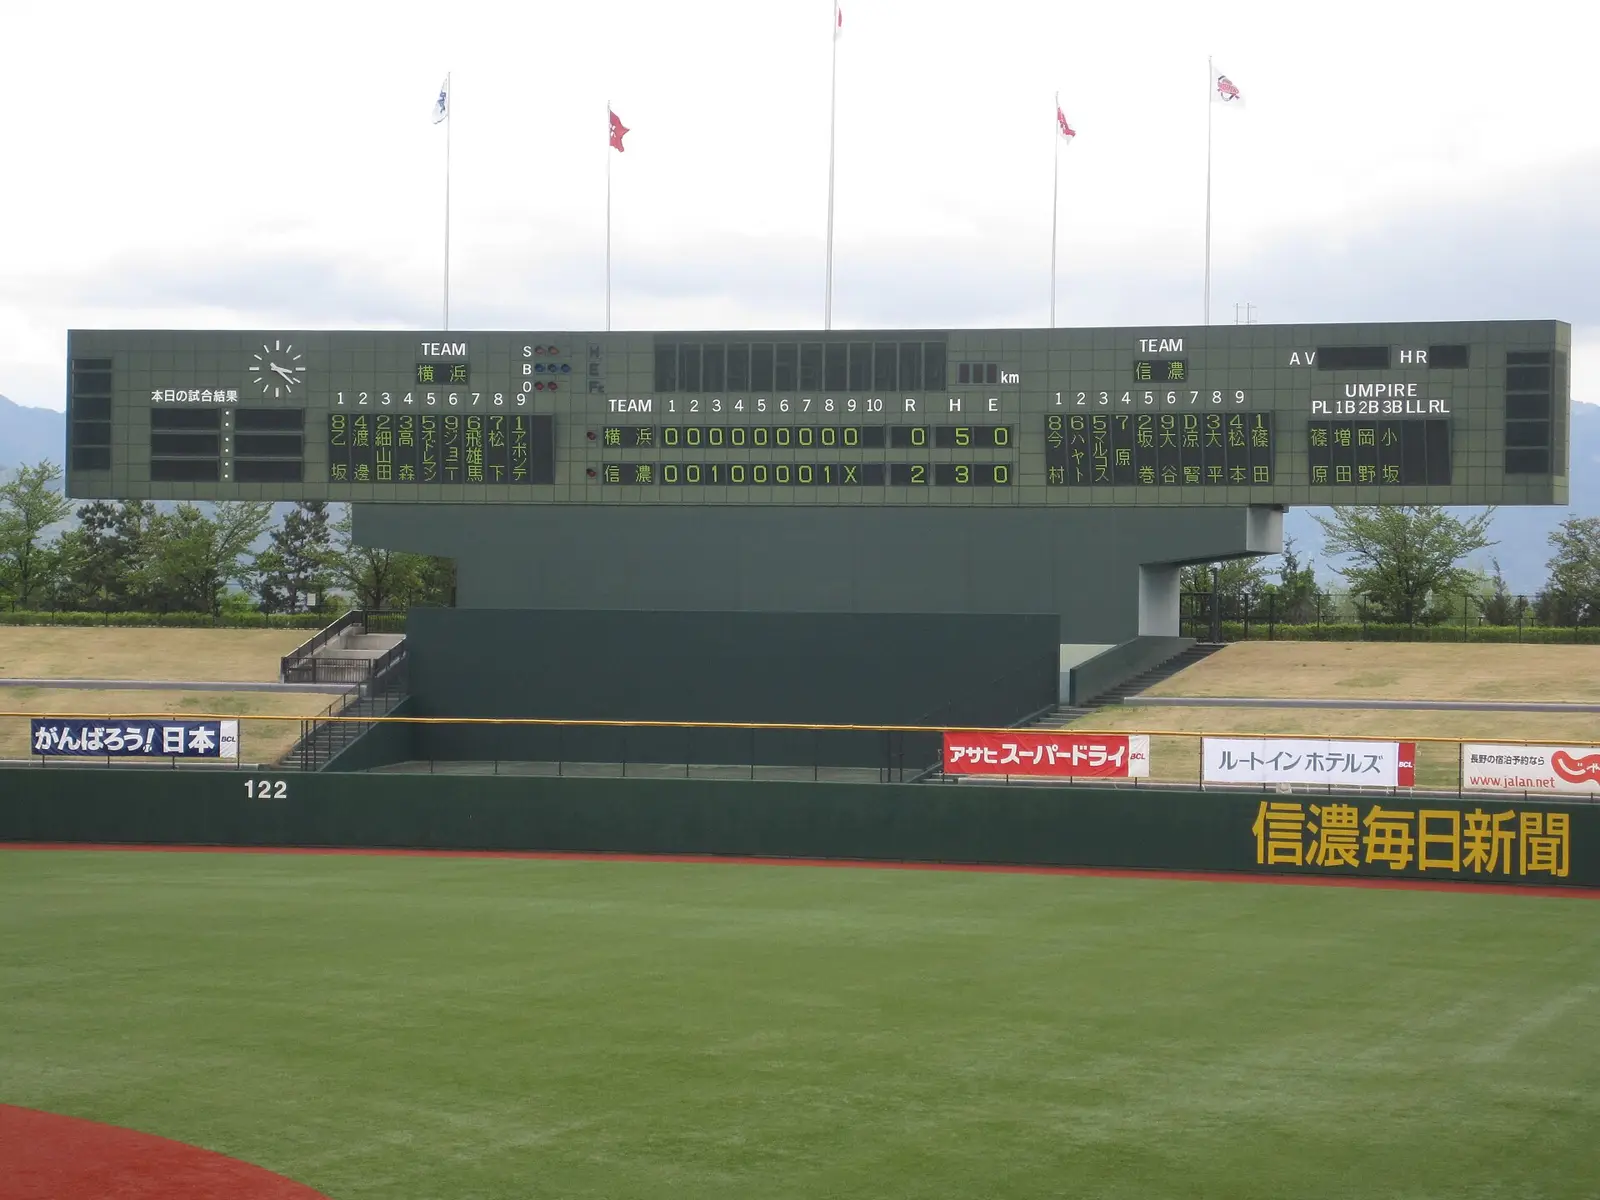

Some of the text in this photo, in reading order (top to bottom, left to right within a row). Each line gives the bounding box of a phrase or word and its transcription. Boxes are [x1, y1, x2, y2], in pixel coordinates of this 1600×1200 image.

[421, 342, 466, 356] TEAM
[522, 345, 532, 358] S
[1139, 338, 1183, 353] TEAM
[417, 364, 466, 382] 横浜
[522, 363, 532, 375] B
[1135, 361, 1184, 380] 信濃
[1000, 370, 1020, 384] km
[151, 389, 238, 403] 本日の試合結果
[1055, 390, 1245, 405] 1 2 3 4 5 6 7 8 9
[1345, 383, 1418, 398] UMPIRE
[337, 391, 526, 406] 1 2 3 4 5 6 7 8 9
[608, 398, 998, 413] TEAM 1 2 3 4 5 6 7 8 9 10 R H E
[1312, 399, 1450, 414] PL 1B 2B 3B LL RL
[604, 427, 1008, 446] 横浜 0 0 0 0 0 0 0 0 0 0 5 0
[605, 464, 652, 483] 信濃
[664, 464, 678, 483] 0
[686, 464, 701, 483] 0
[711, 465, 718, 483] 1
[731, 464, 745, 483] 0
[753, 464, 768, 484] 0
[775, 465, 790, 484] 0
[798, 465, 813, 484] 0
[823, 465, 830, 484] 1
[910, 465, 925, 484] 2
[955, 465, 969, 484] 3
[993, 465, 1008, 484] 0
[163, 726, 215, 753] 日本
[220, 735, 237, 744] BCL
[1129, 752, 1146, 760] BCL
[1470, 753, 1545, 766] 長野の宿泊予約なら
[244, 779, 287, 799] 122
[1468, 775, 1556, 790] www.jalan.net
[1252, 801, 1569, 876] 信濃毎日新聞
